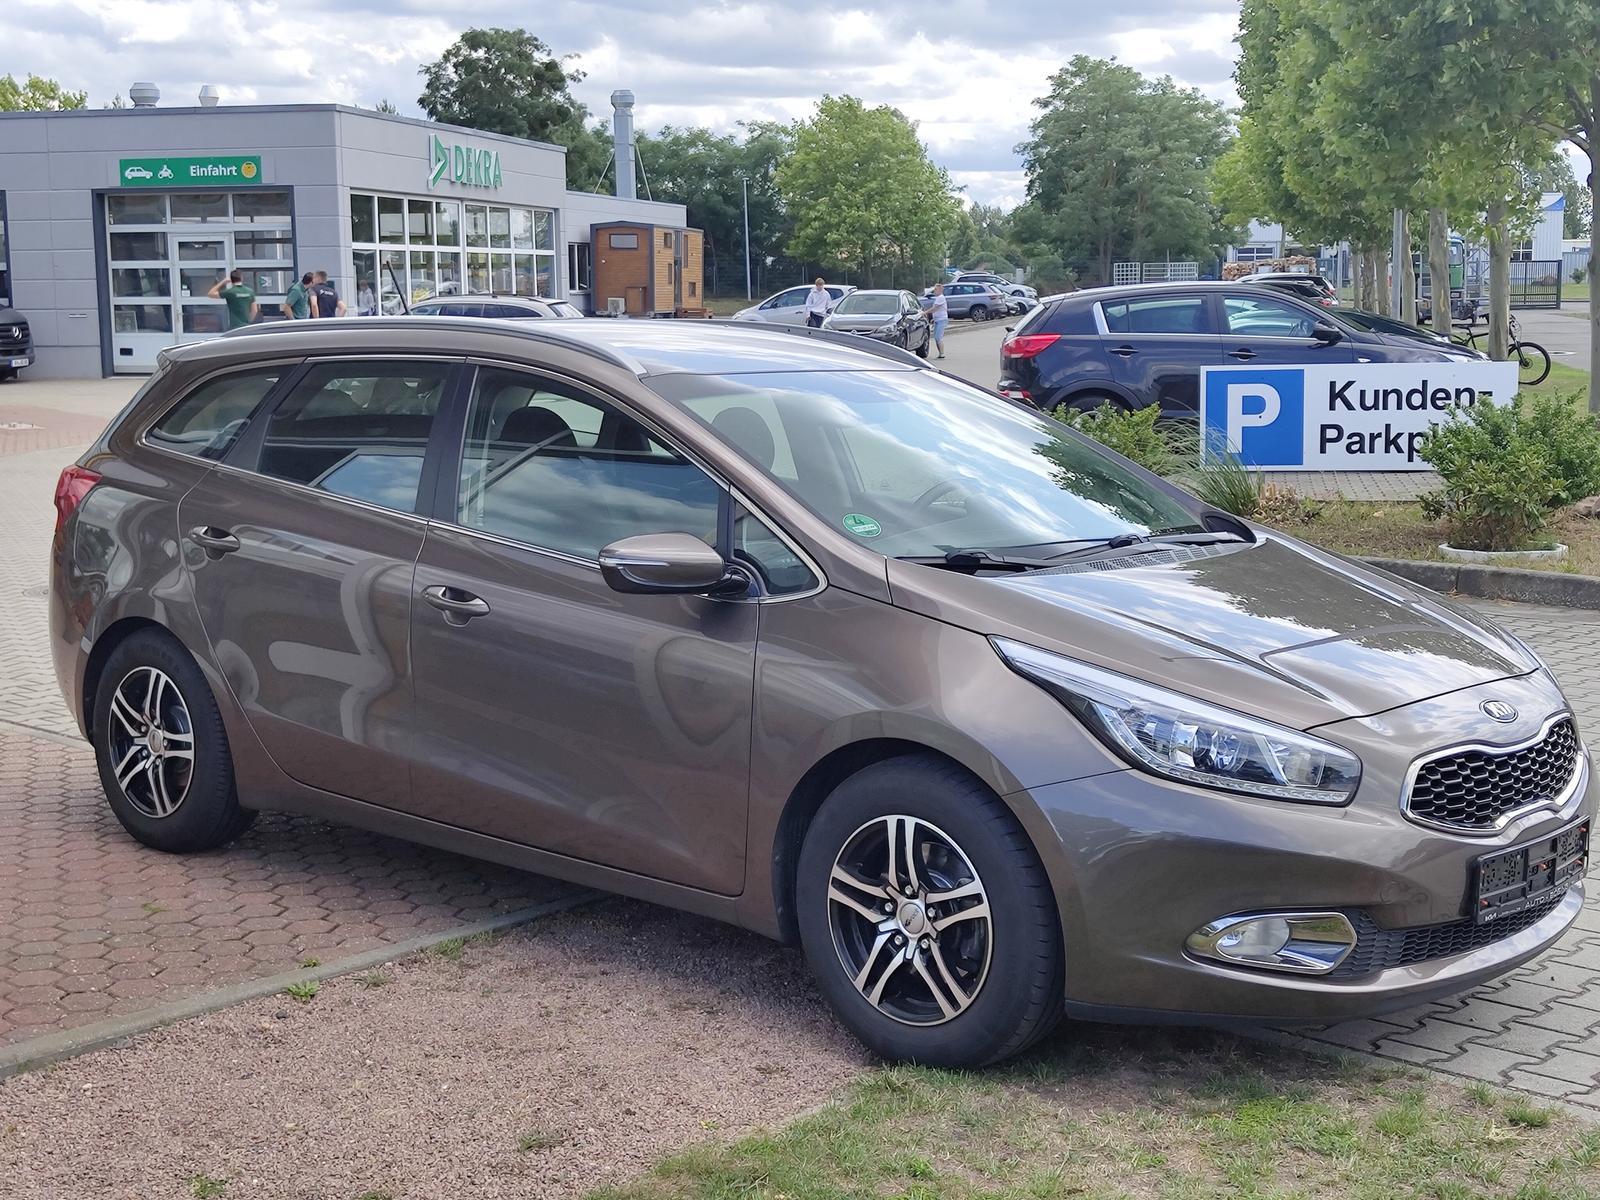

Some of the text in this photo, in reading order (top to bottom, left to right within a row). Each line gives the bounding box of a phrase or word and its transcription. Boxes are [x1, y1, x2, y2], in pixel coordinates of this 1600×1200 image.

[189, 164, 238, 177] Einfahrt
[452, 144, 503, 187] DEKRA
[1328, 379, 1493, 412] Kunden-
[1226, 383, 1281, 454] P
[1318, 422, 1439, 463] Parkp
